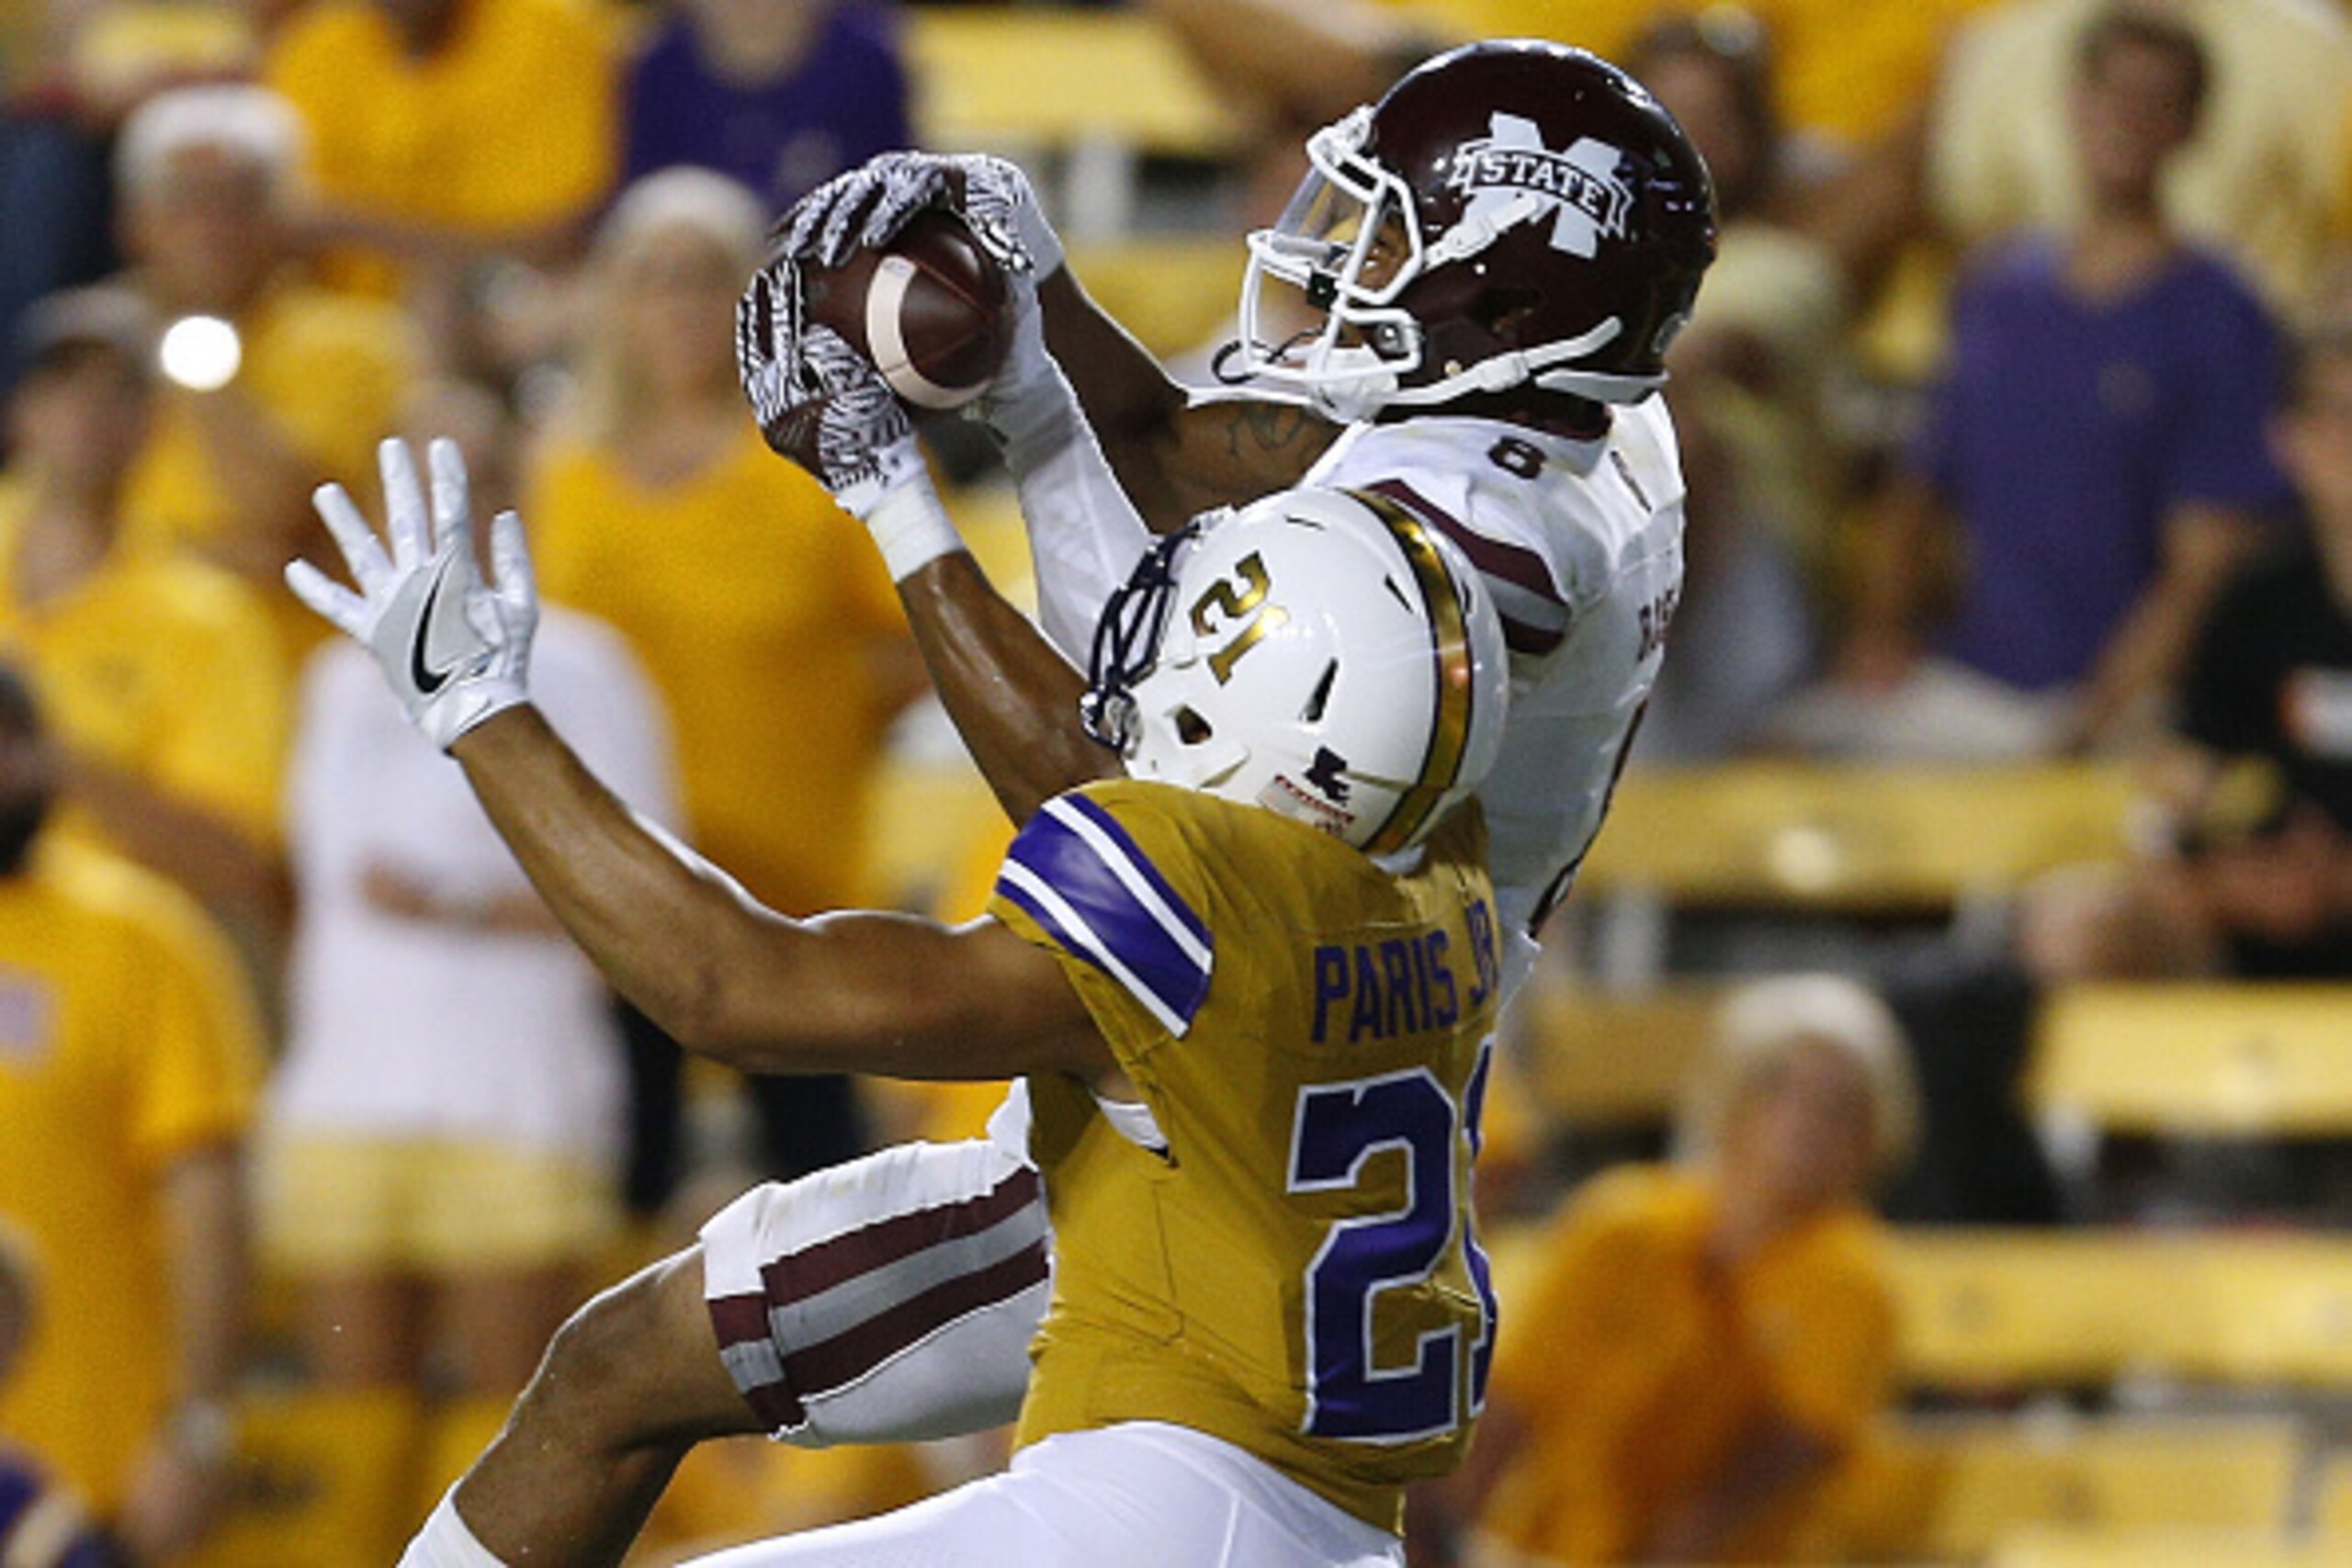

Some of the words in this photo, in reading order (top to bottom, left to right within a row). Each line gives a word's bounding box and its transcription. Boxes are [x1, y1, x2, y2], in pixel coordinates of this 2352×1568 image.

[1479, 152, 1604, 216] STATE
[1188, 549, 1291, 687] 21
[1311, 929, 1458, 1044] PARIS
